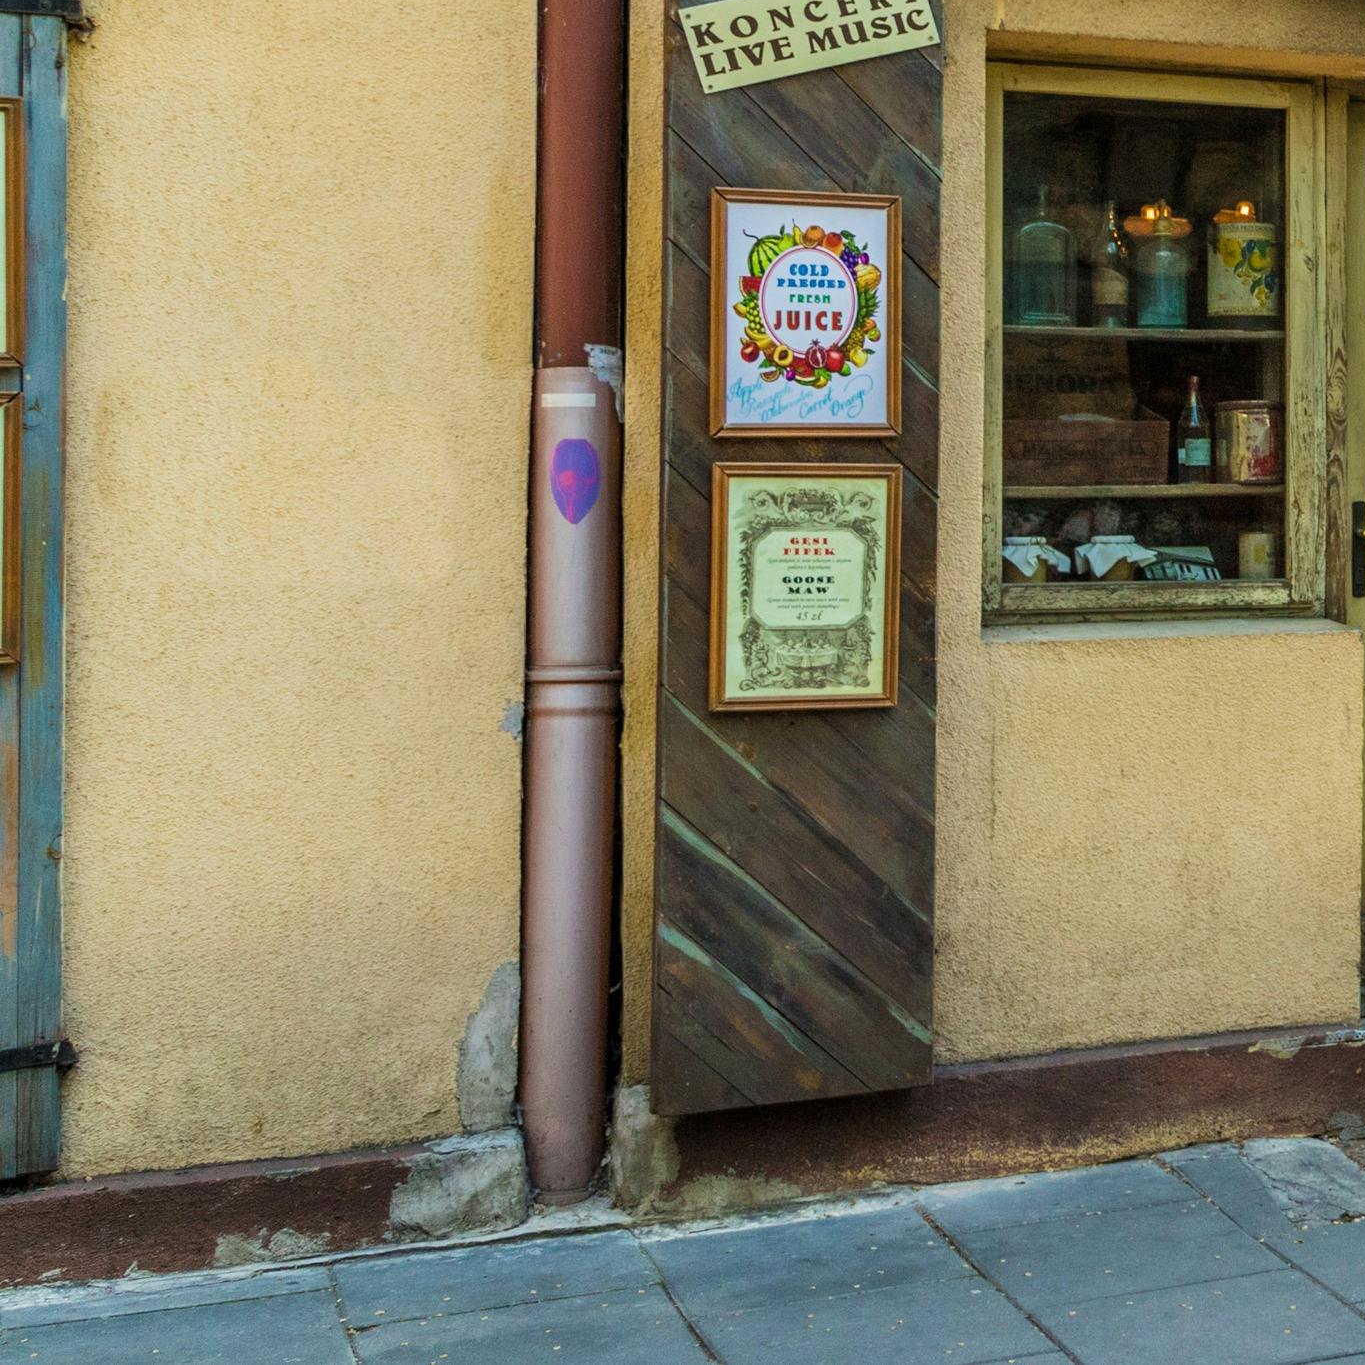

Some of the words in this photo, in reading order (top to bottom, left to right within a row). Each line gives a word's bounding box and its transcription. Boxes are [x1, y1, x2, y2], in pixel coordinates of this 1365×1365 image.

[699, 36, 795, 77] LIVE
[805, 9, 930, 54] MUSIC
[789, 264, 829, 277] COLD
[777, 278, 847, 289] PRESSED
[789, 294, 831, 304] FRESH
[774, 310, 843, 331] JUICE
[782, 576, 835, 584] GOOSE
[787, 586, 830, 595] MAW
